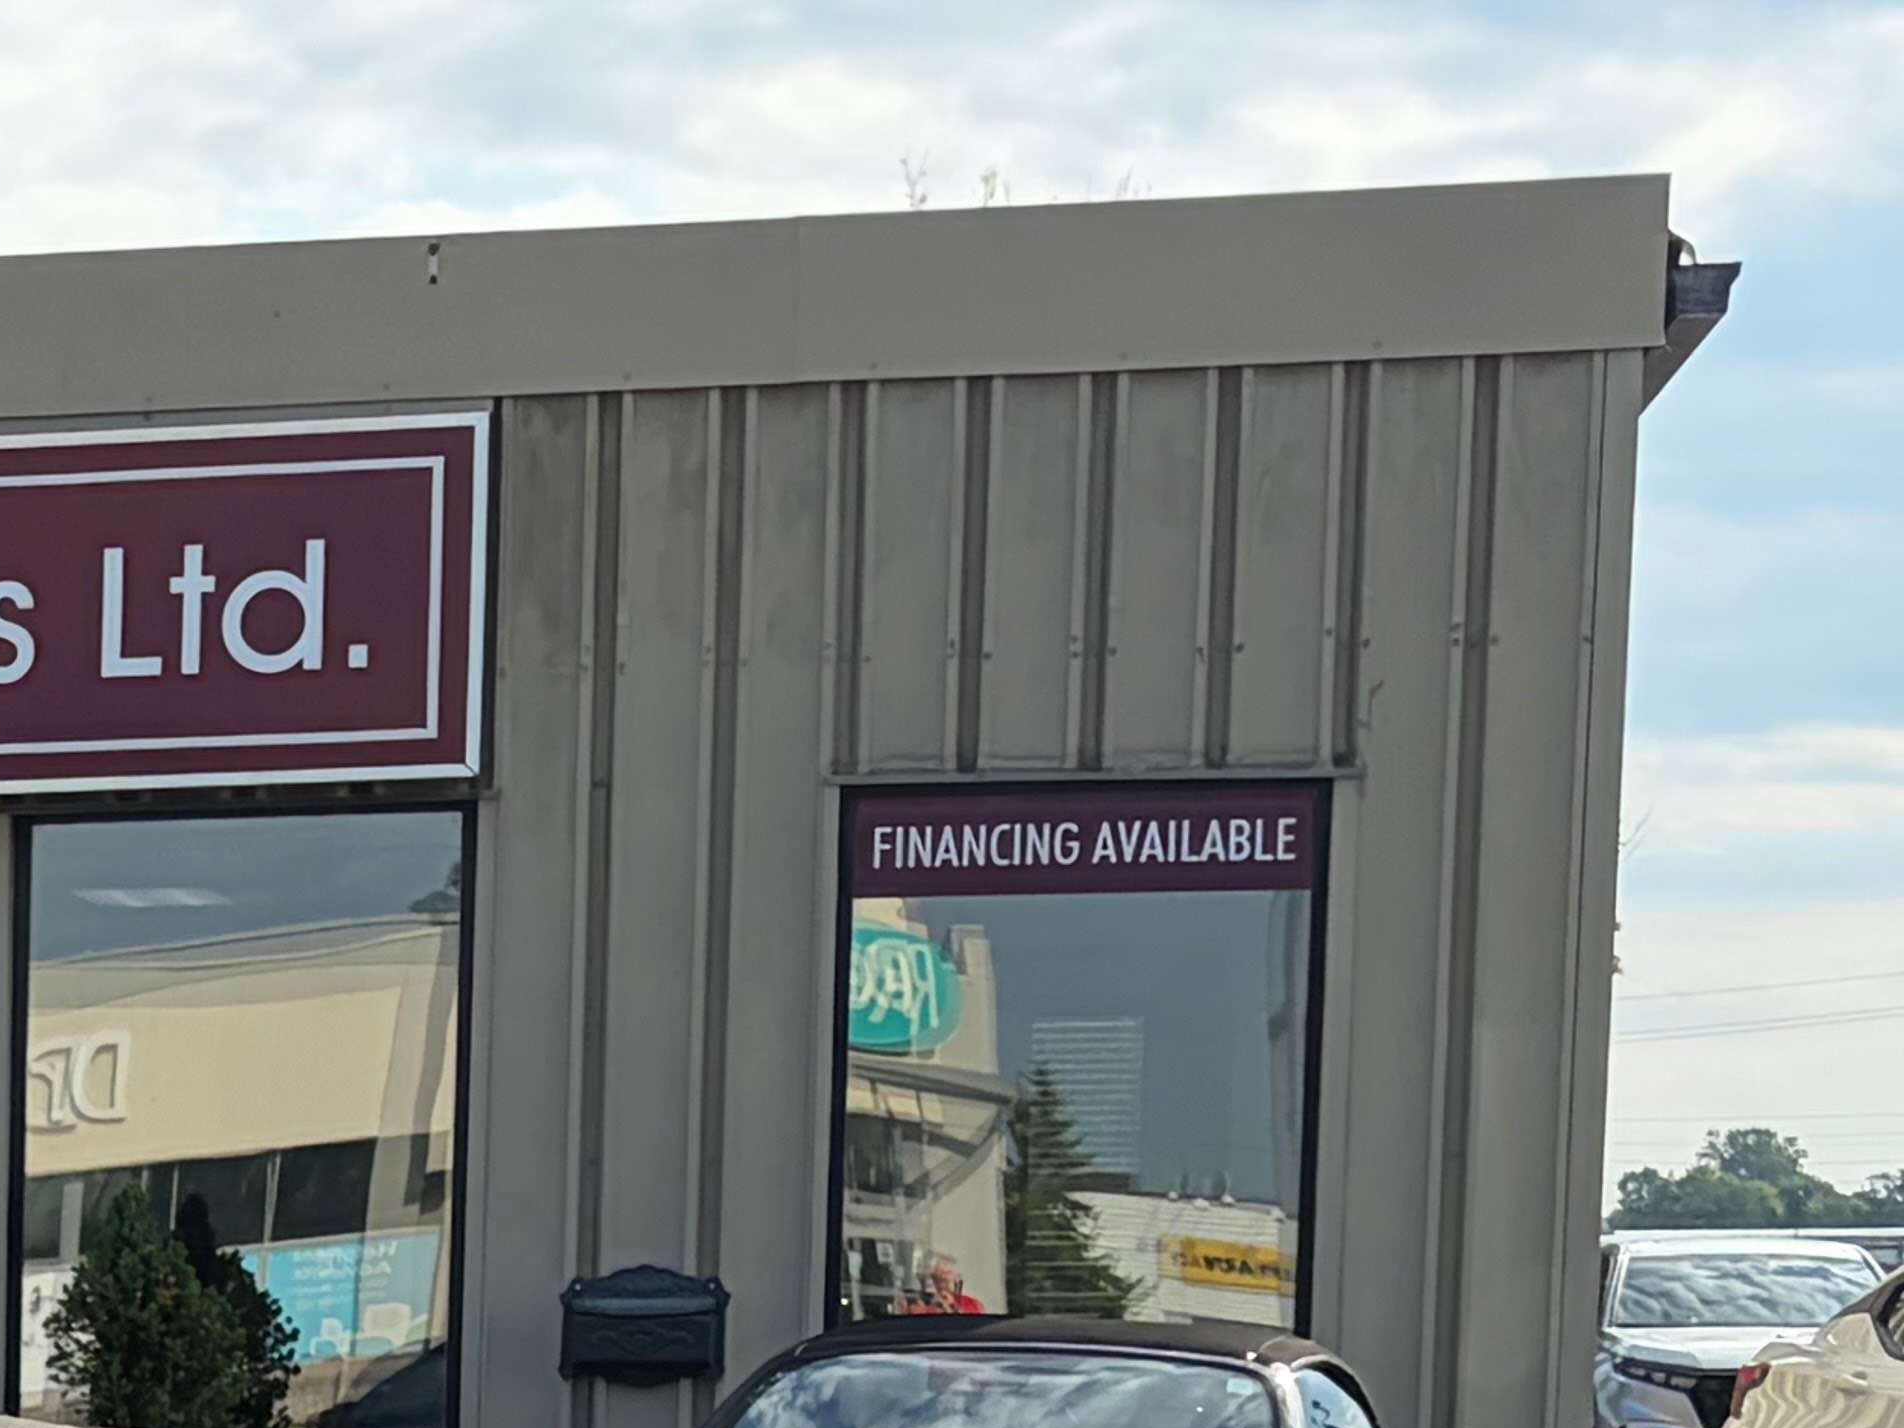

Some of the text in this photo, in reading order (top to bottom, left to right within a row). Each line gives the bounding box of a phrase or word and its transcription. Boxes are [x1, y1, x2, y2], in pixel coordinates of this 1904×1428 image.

[100, 538, 369, 679] Ltd.
[872, 818, 1297, 869] FINANCING AVAILABLE
